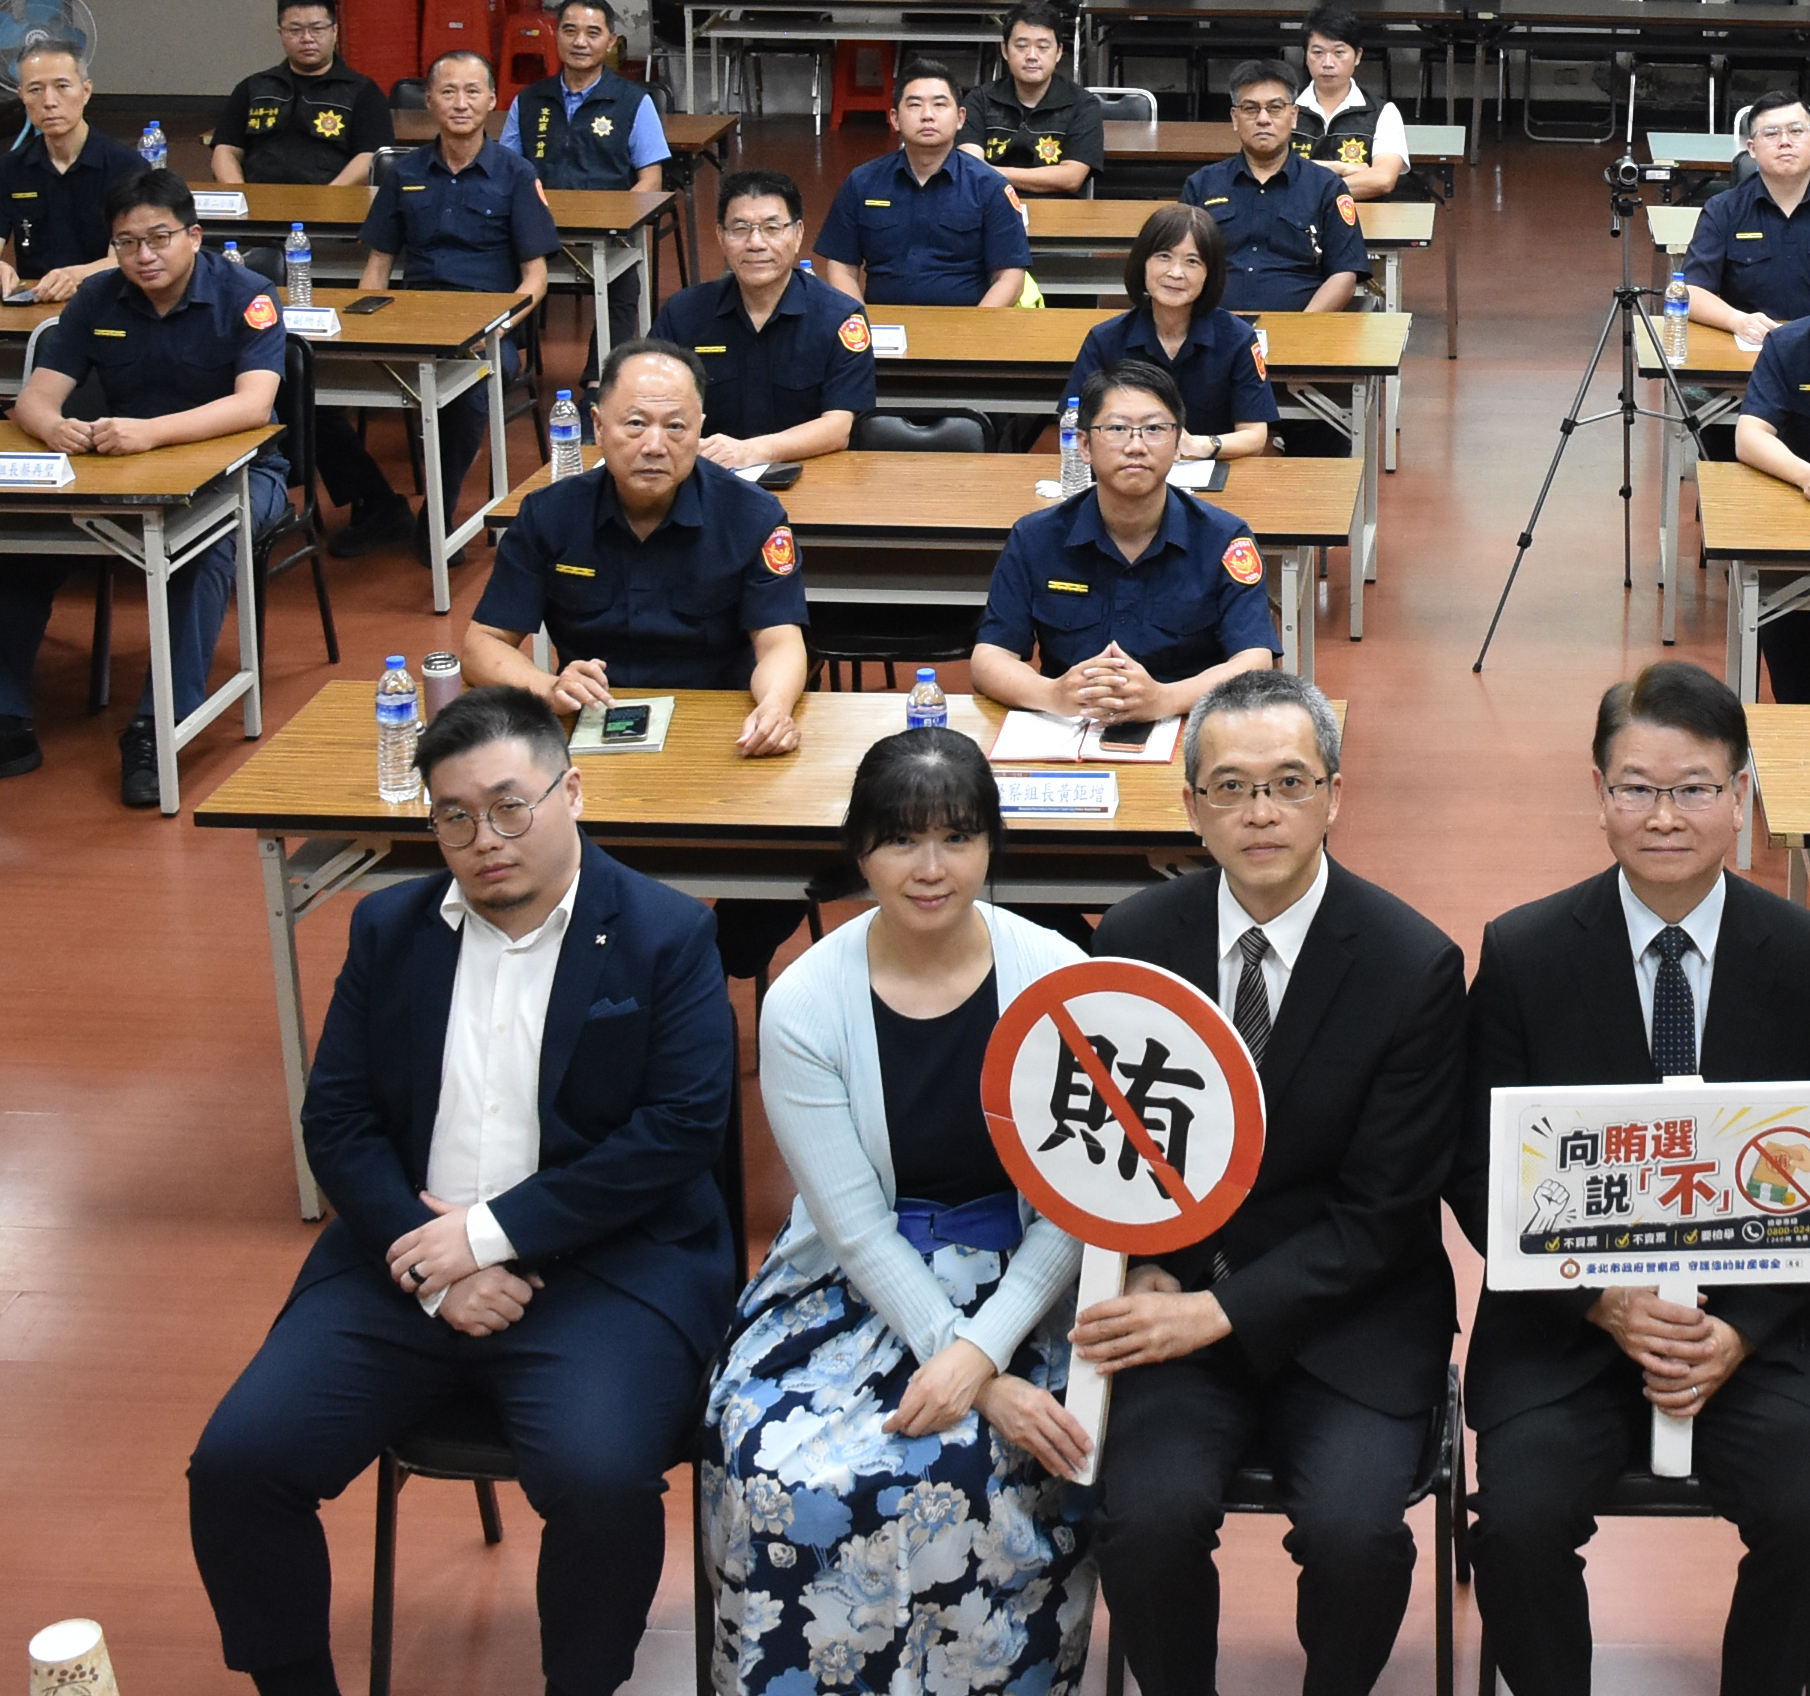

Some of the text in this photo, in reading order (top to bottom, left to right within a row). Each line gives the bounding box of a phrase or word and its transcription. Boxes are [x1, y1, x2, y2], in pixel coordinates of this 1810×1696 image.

[1037, 1033, 1206, 1200] 賄
[1559, 1118, 1695, 1169] 向賄選
